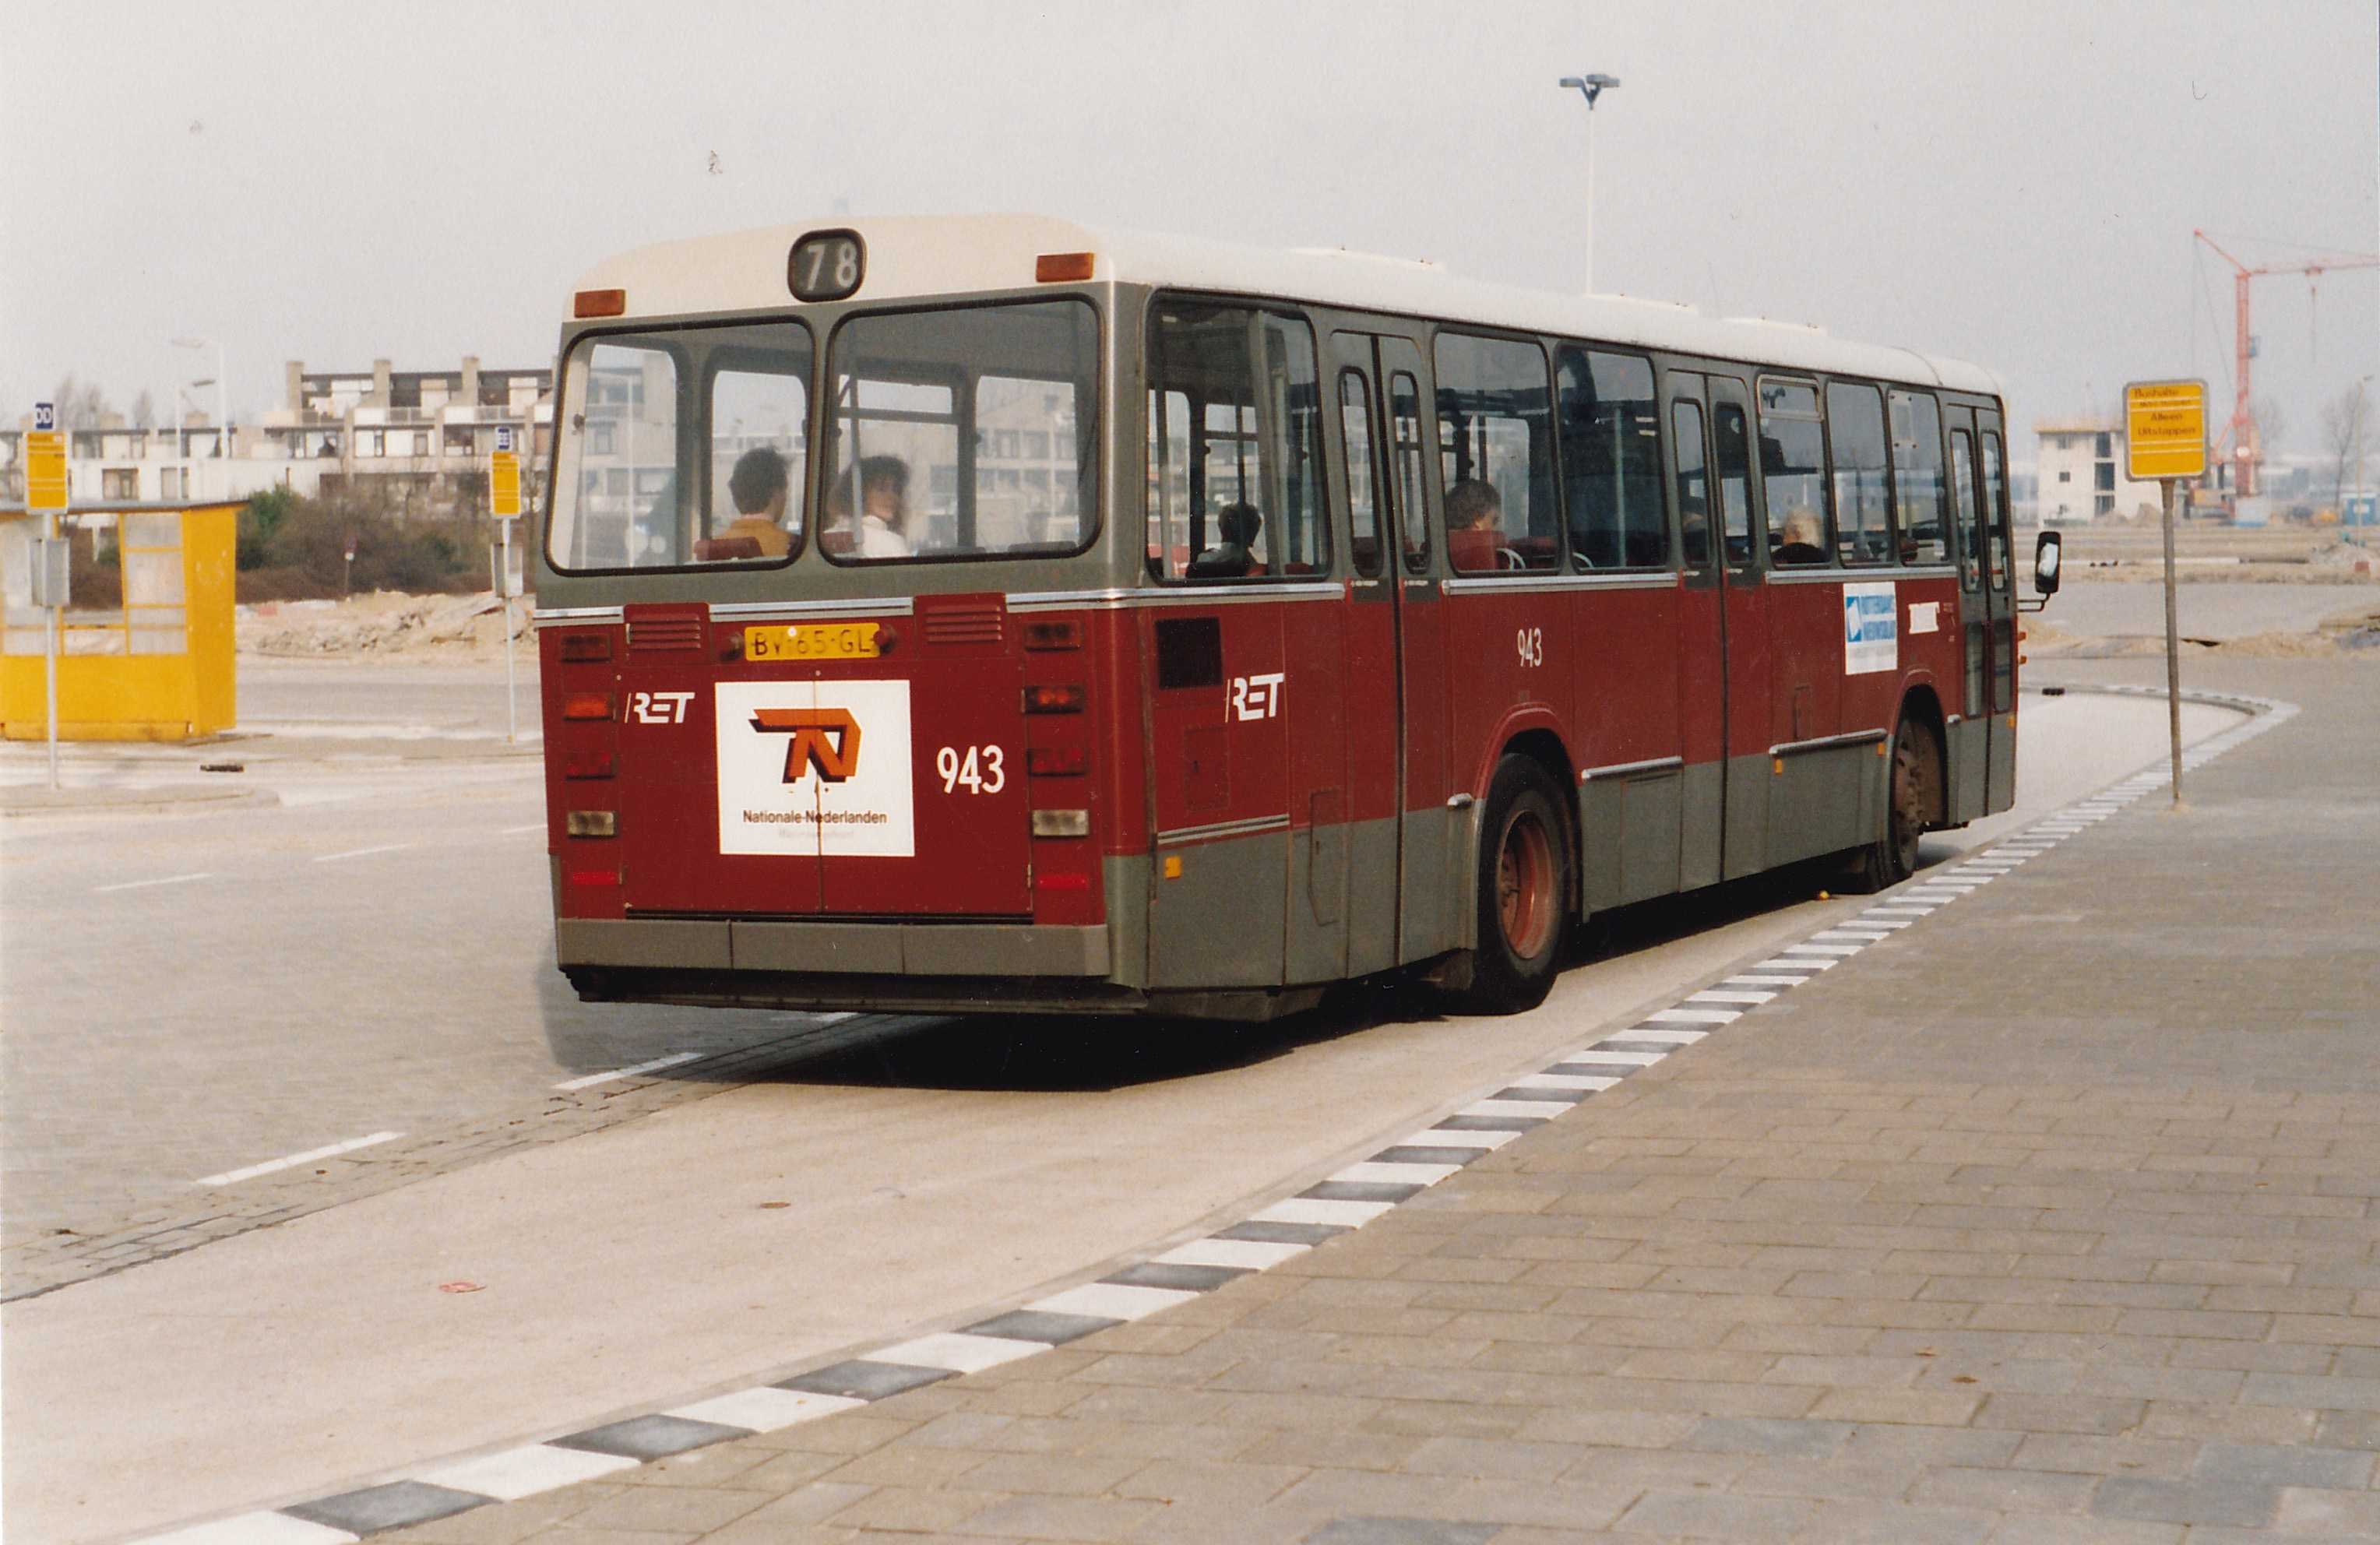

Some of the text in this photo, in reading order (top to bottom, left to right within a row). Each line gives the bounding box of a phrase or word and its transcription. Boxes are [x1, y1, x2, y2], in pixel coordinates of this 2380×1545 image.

[806, 241, 858, 291] 78
[1517, 627, 1543, 668] 943
[624, 692, 696, 723] RET
[1224, 672, 1284, 723] RET
[936, 744, 1005, 794] 943
